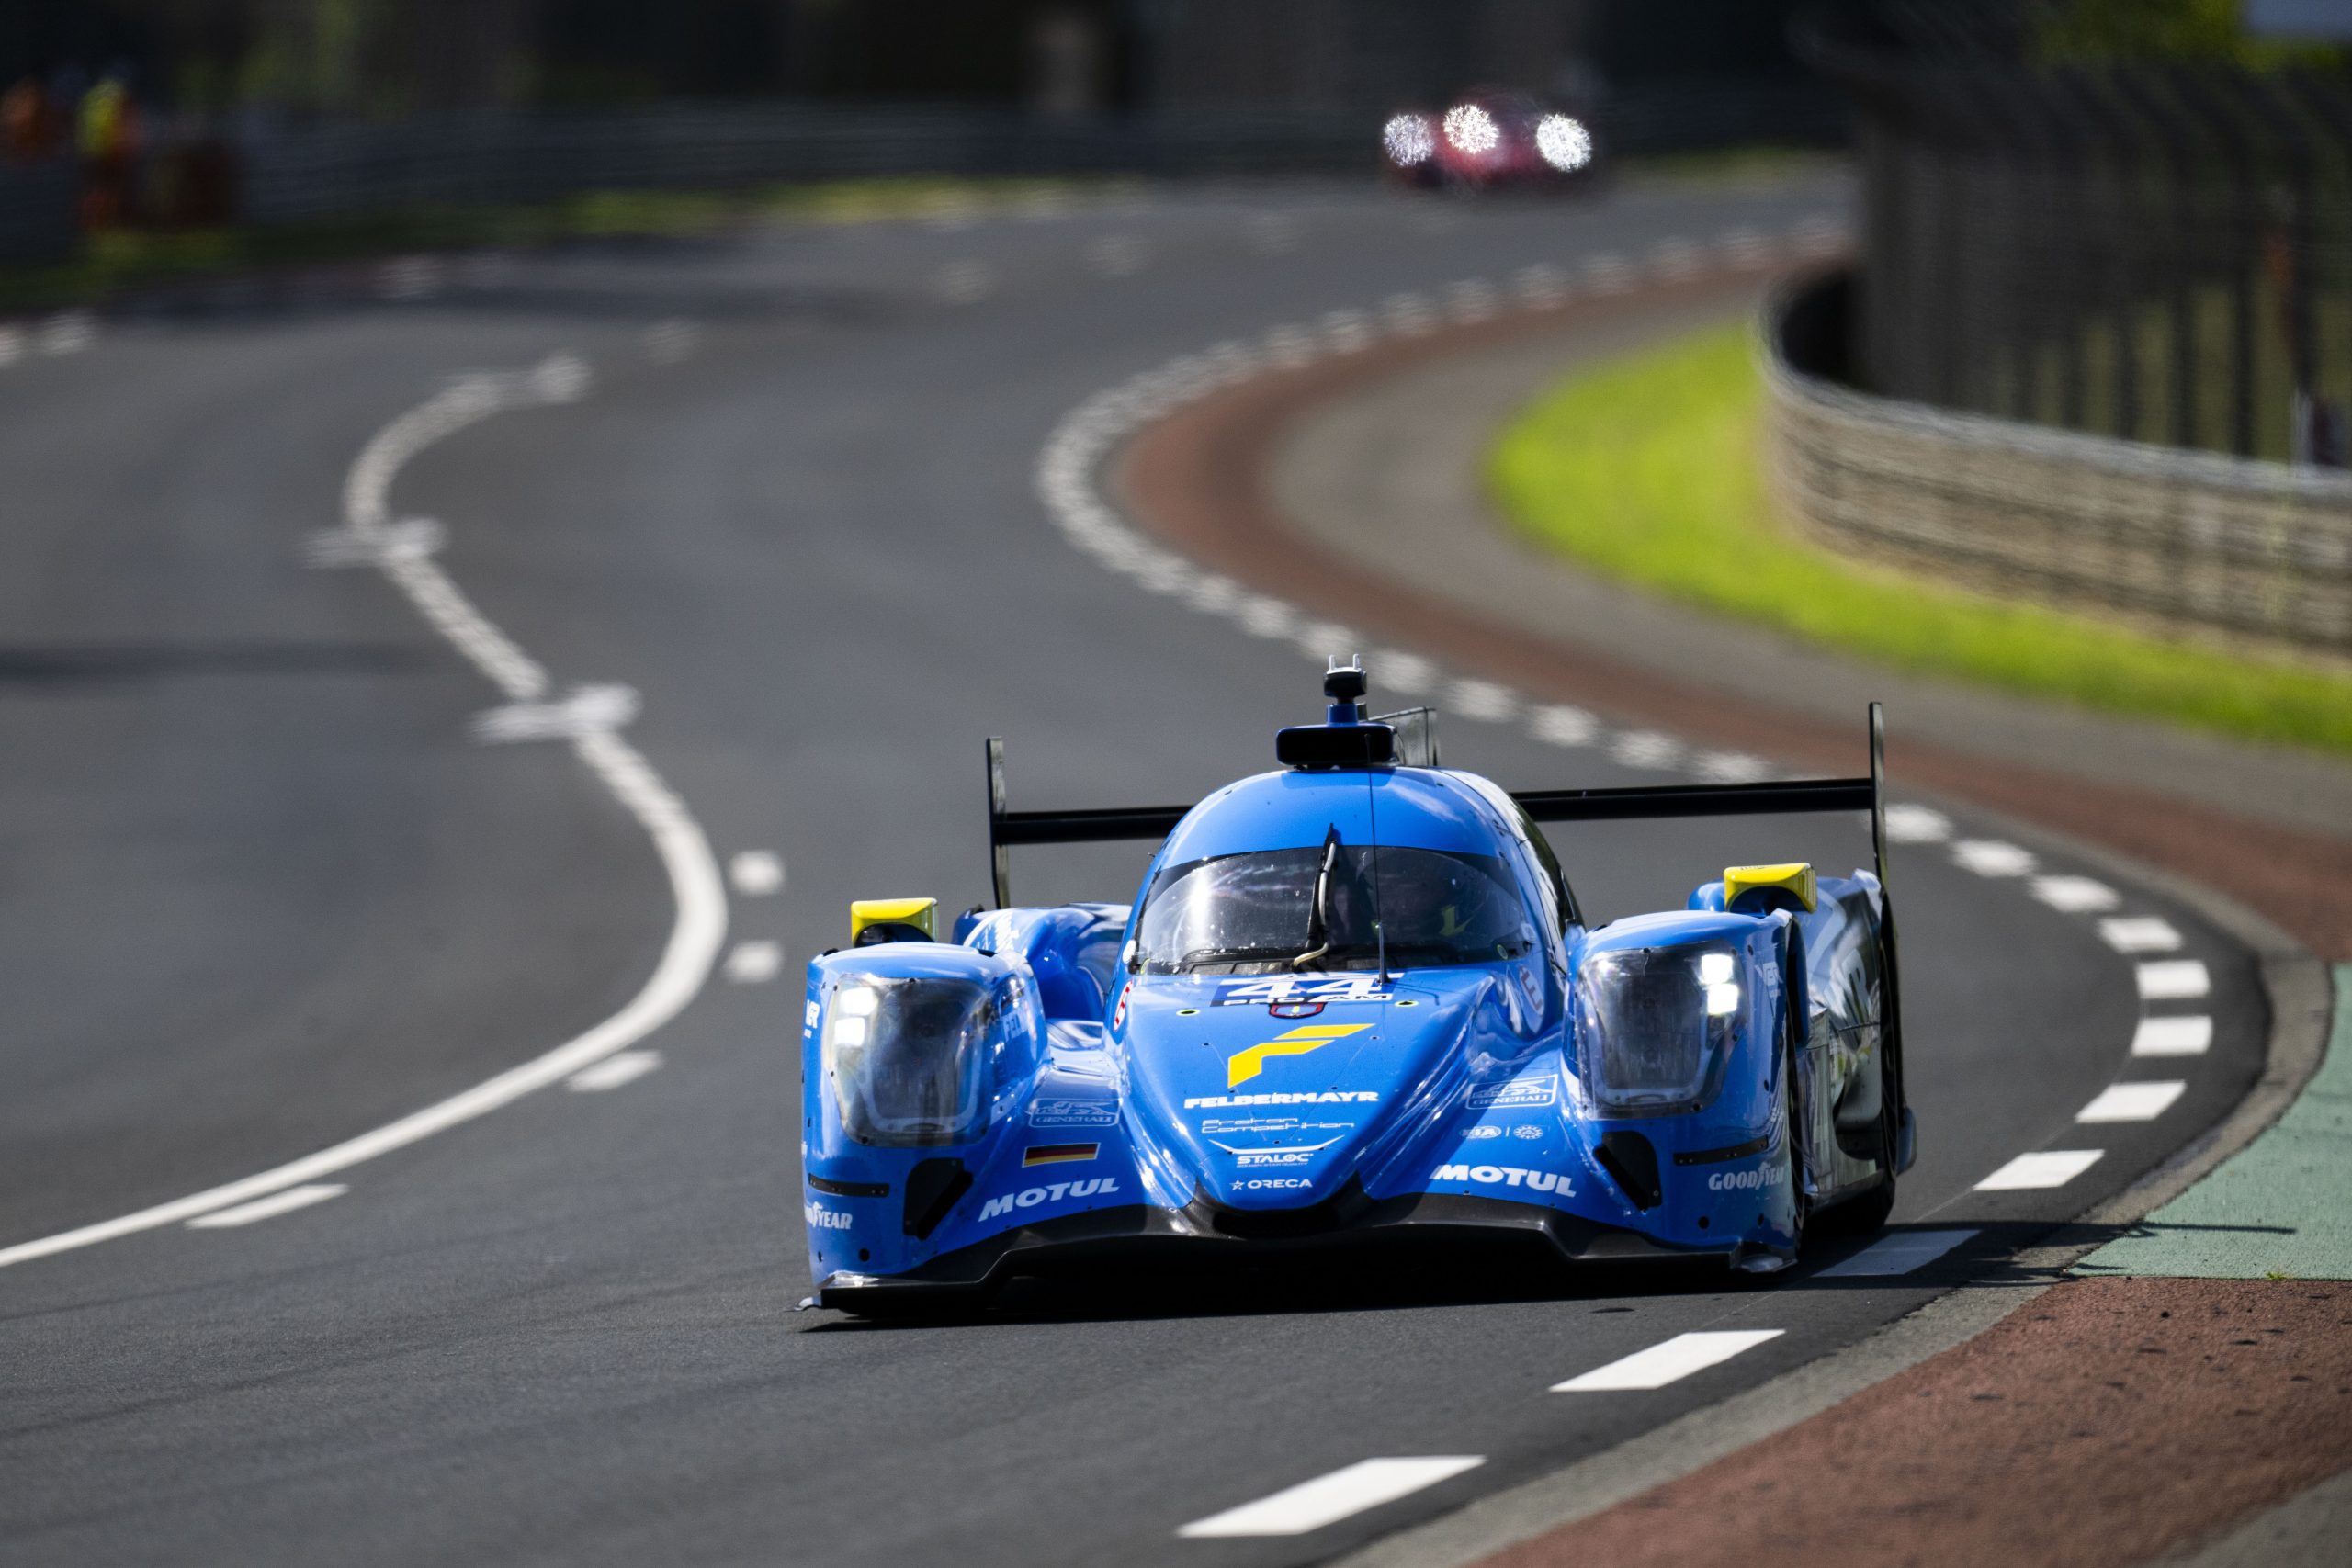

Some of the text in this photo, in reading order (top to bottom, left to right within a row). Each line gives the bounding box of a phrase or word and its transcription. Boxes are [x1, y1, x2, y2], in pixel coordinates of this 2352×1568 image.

[1226, 977, 1383, 998] 44
[1223, 997, 1305, 1006] PRO
[1183, 1091, 1379, 1109] FELBERMAYR
[1472, 1094, 1549, 1104] GENERALI
[1202, 1122, 1355, 1134] Competition
[1203, 1118, 1298, 1126] Proton
[1237, 1154, 1310, 1166] STALOC
[1429, 1164, 1577, 1198] MOTUL
[1708, 1161, 1786, 1190] GOODYEA
[1247, 1179, 1313, 1189] ORECA
[978, 1178, 1120, 1223] MOTUL
